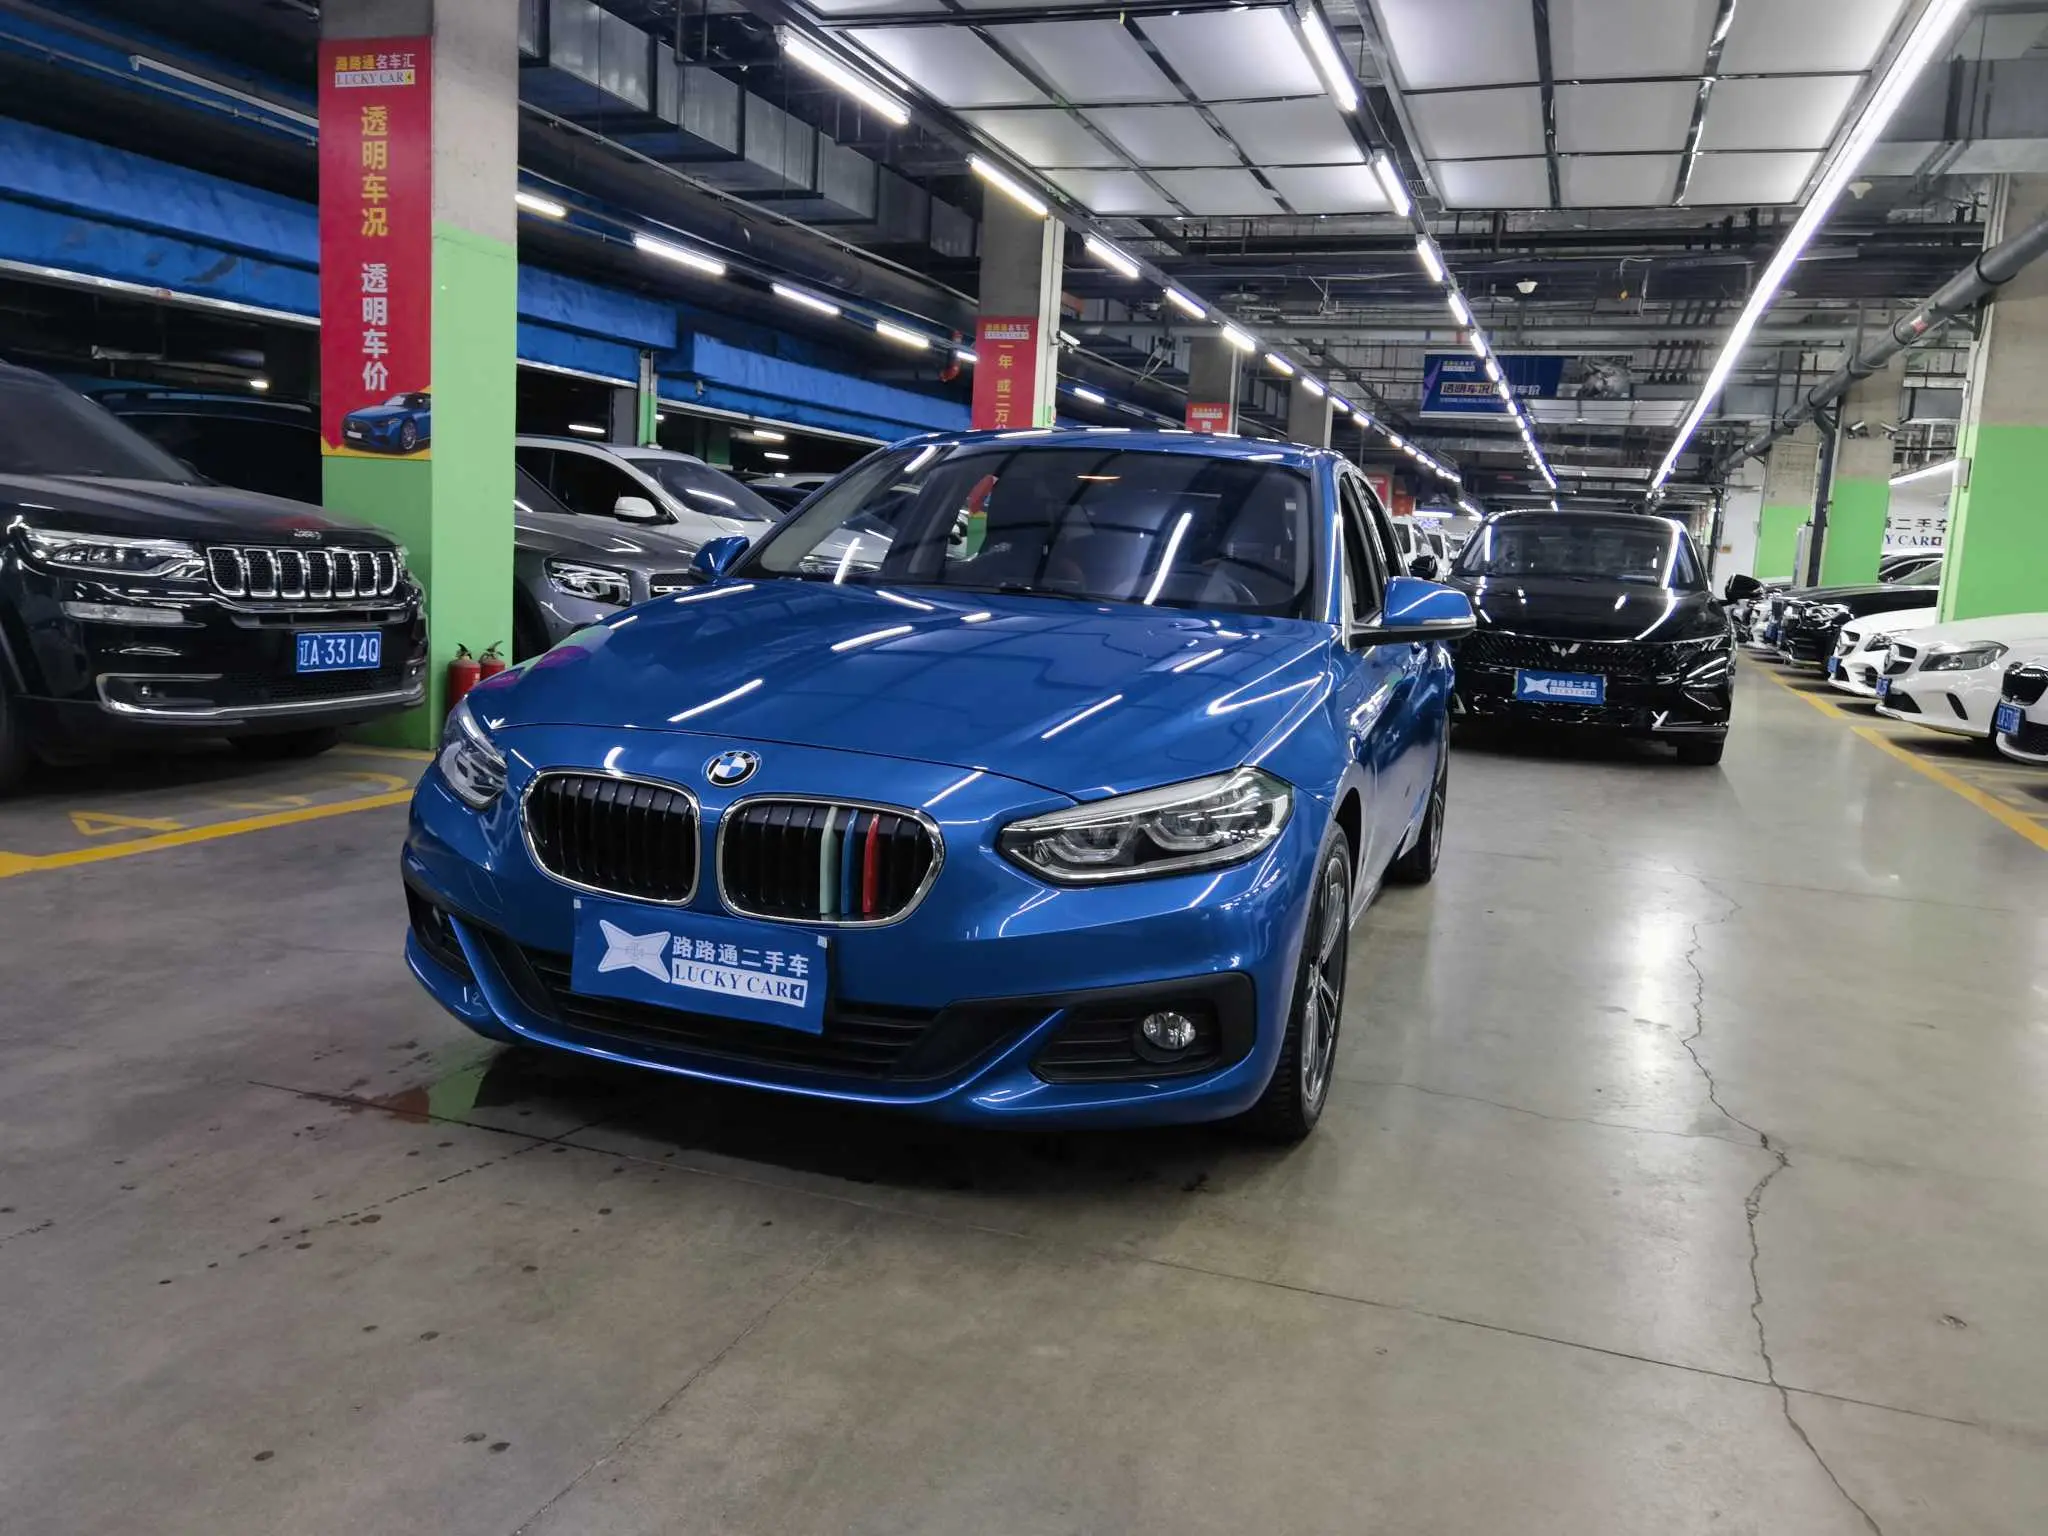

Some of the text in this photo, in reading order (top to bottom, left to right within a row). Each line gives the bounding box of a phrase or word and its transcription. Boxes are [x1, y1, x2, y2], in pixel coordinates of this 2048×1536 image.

[336, 72, 404, 86] LUCKY CAR
[360, 105, 389, 237] 透明车况
[361, 263, 389, 391] 透明车价
[1898, 535, 1930, 546] CAR
[672, 935, 810, 978] 路路通二手车
[674, 963, 789, 998] LUCKY CAR
